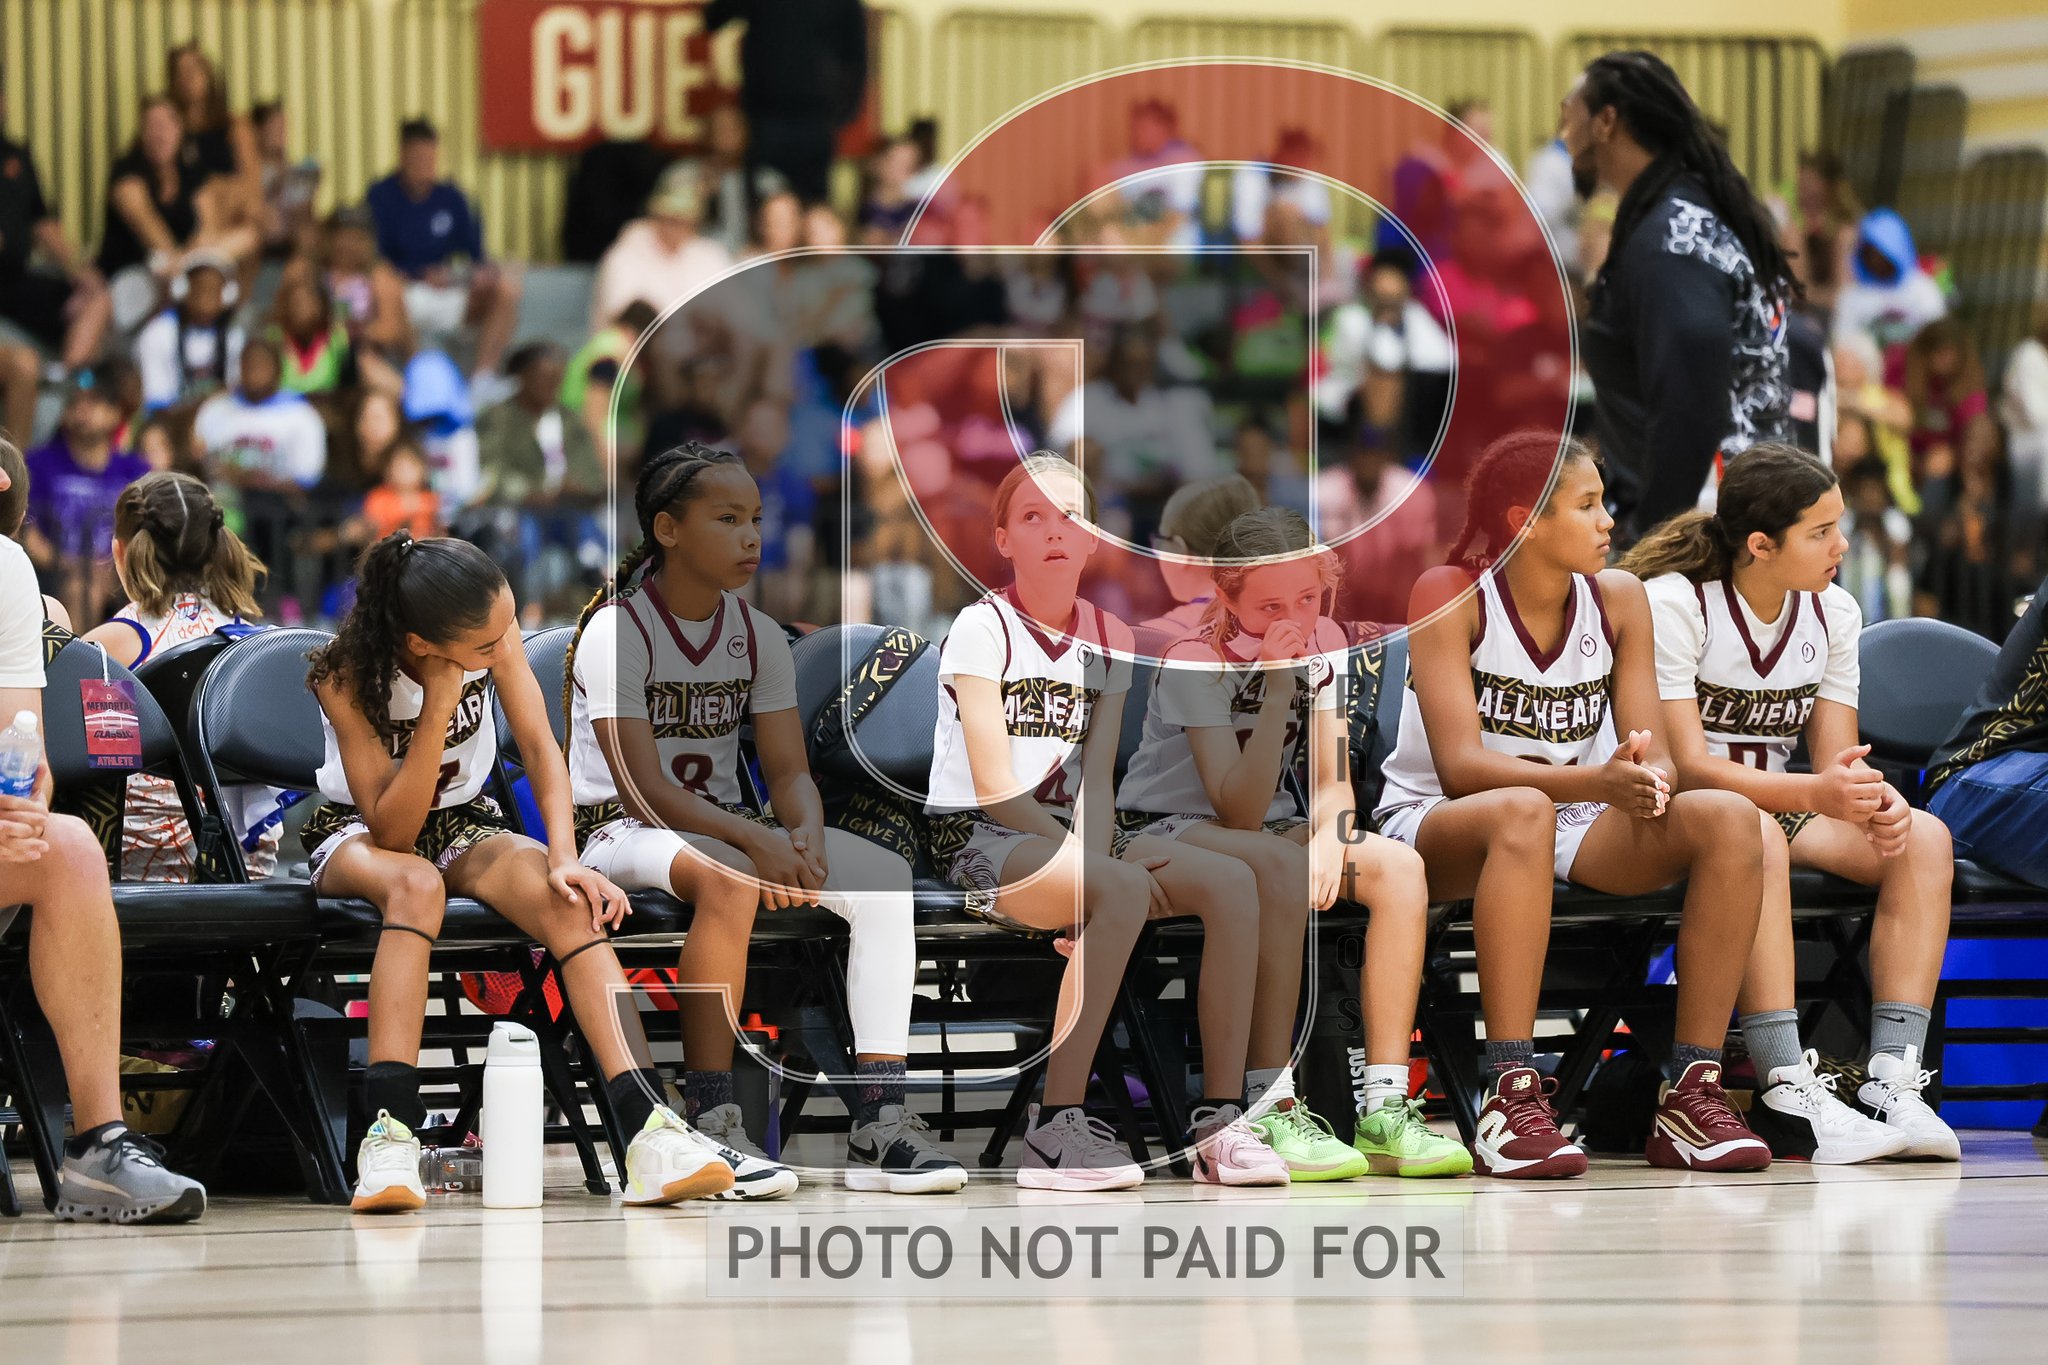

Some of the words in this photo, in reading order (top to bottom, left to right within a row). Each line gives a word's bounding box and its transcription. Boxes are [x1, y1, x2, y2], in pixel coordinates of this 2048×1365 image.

[531, 7, 746, 141] GUE
[651, 695, 680, 725] LL
[1043, 691, 1092, 731] HEAR
[1477, 686, 1533, 724] ALL
[1532, 690, 1606, 730] HEAR
[1700, 695, 1737, 725] LL
[1744, 697, 1815, 726] HEAR
[97, 756, 135, 767] ATHLETE
[848, 817, 896, 842] GAVE
